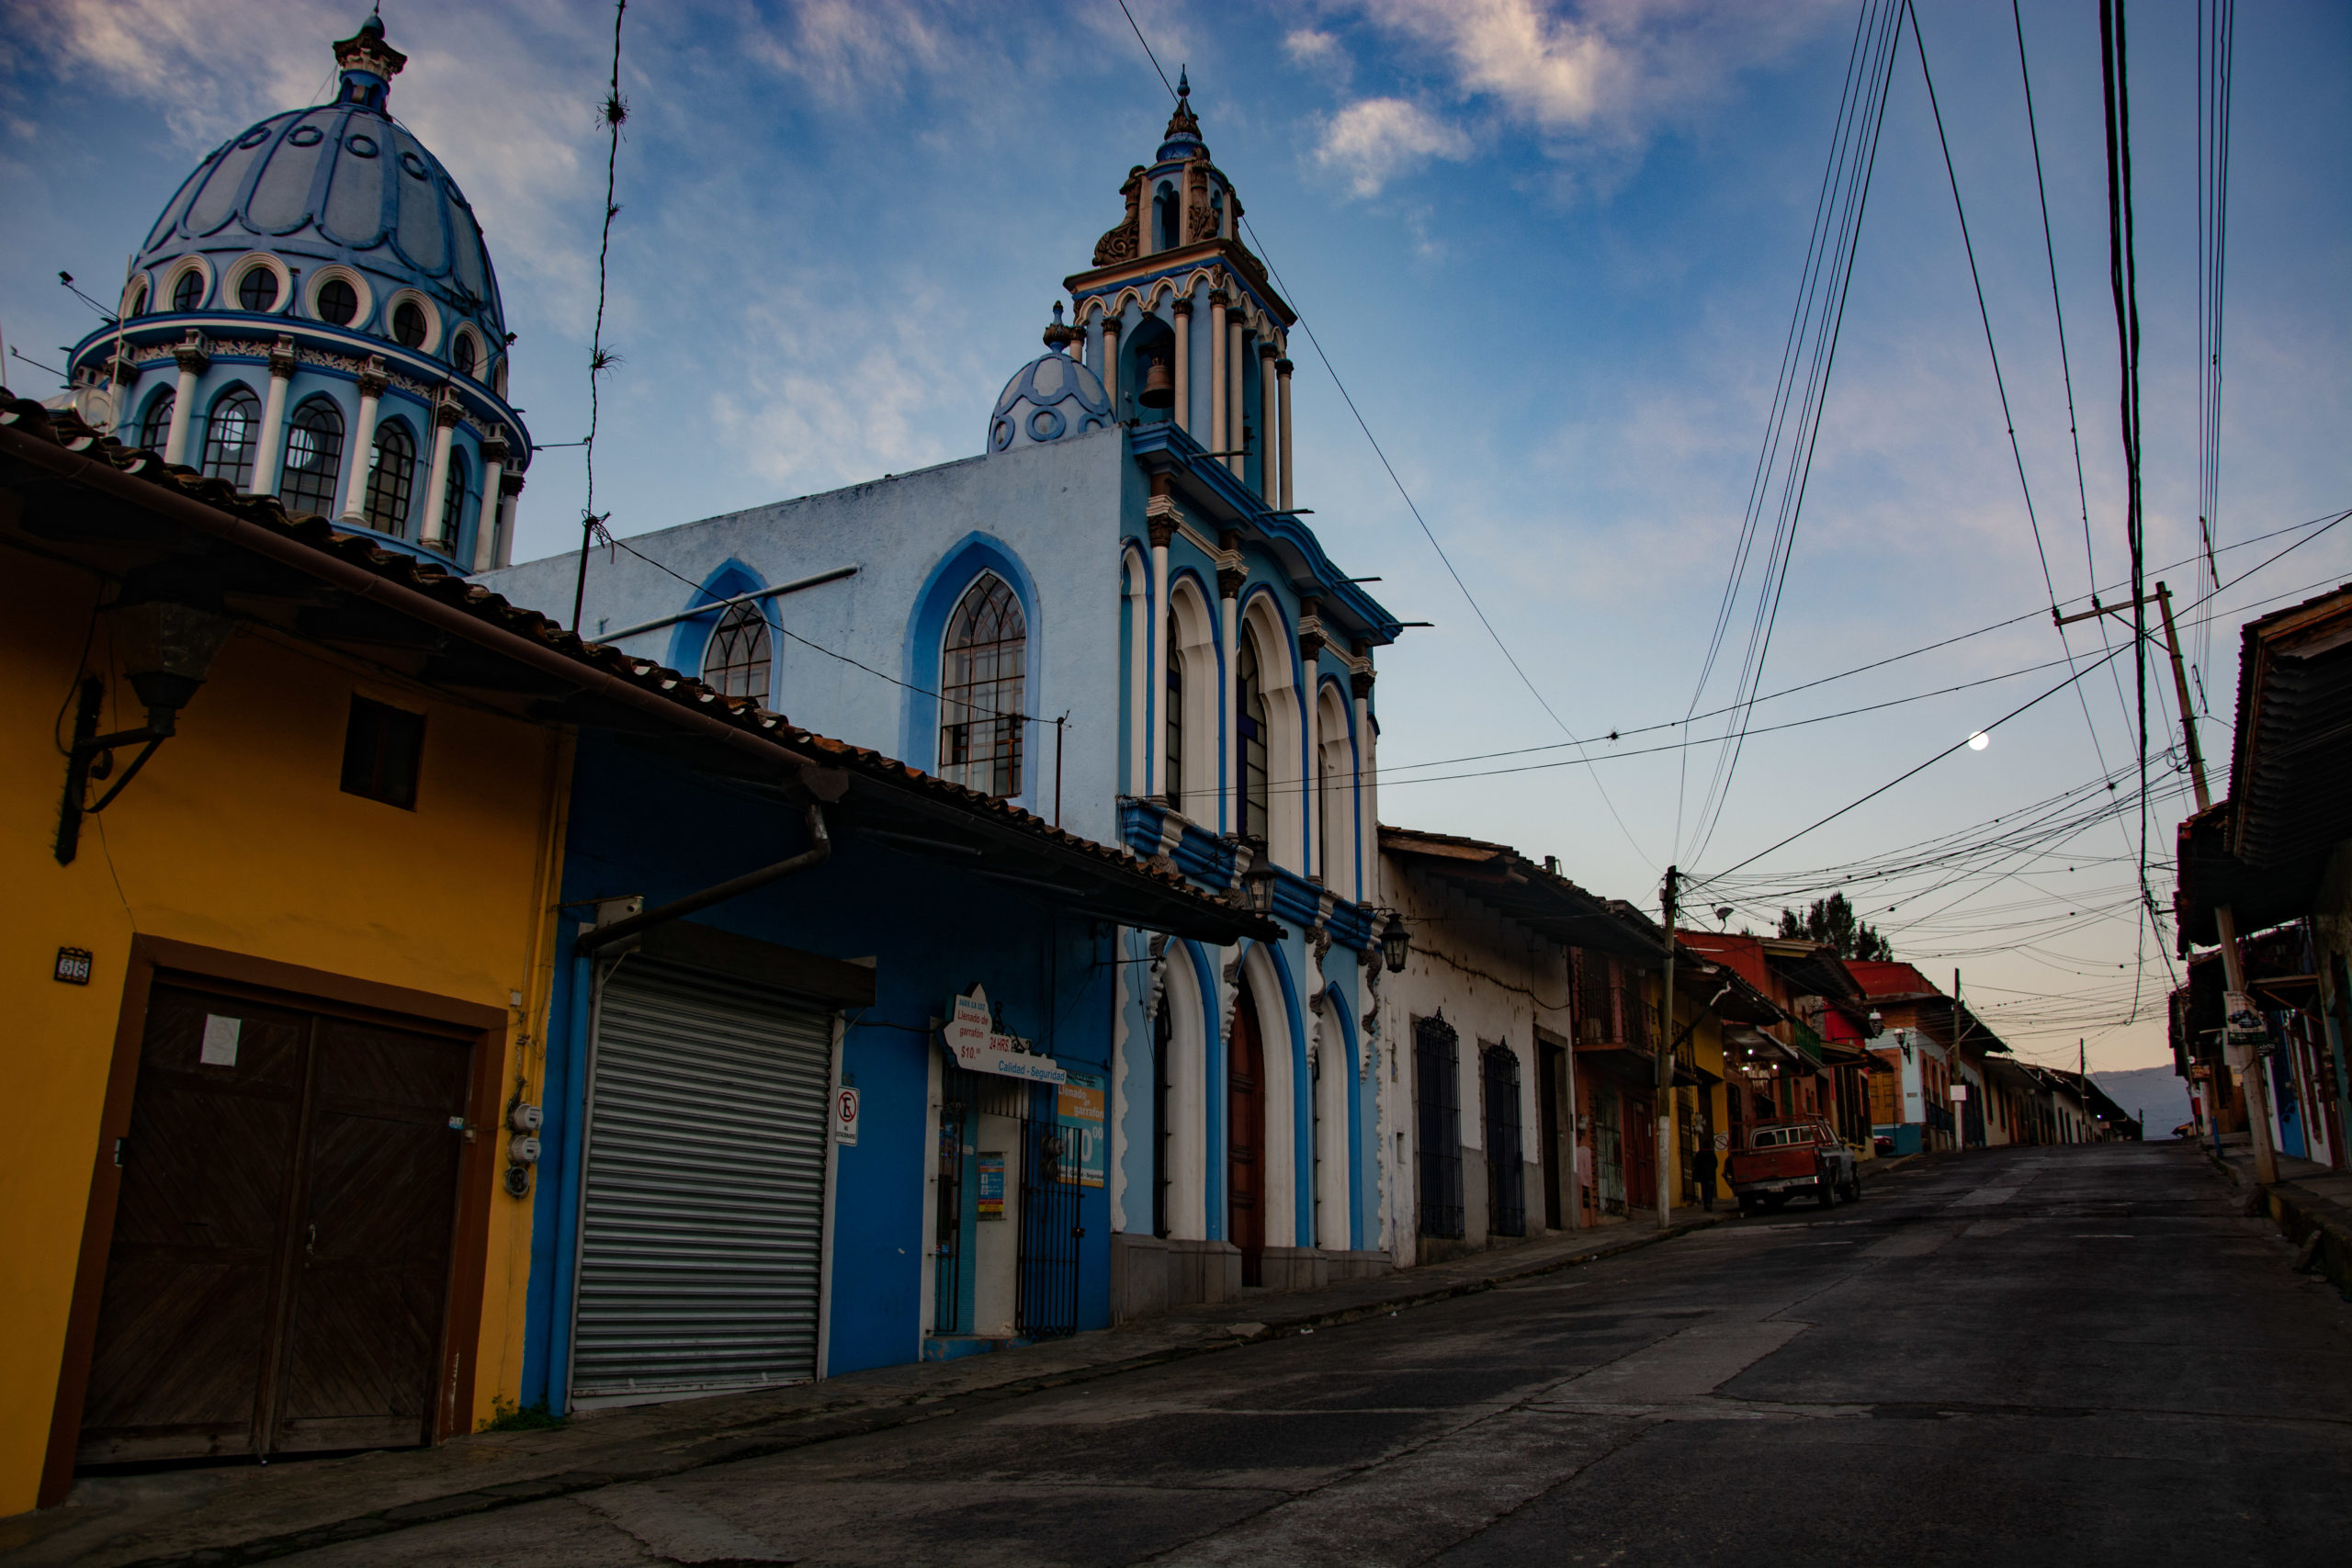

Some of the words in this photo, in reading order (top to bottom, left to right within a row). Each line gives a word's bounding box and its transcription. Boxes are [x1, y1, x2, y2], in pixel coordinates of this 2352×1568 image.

[62, 960, 86, 976] 58
[957, 1010, 980, 1023] Llenado
[981, 1015, 989, 1025] de
[959, 1027, 984, 1039] garrafón
[989, 1037, 997, 1050] 24
[998, 1037, 1010, 1052] HRS.
[998, 1060, 1025, 1074] Calidad
[1030, 1066, 1065, 1081] Seguridad
[1057, 1085, 1087, 1100] Llenado
[1073, 1106, 1104, 1119] garrafón
